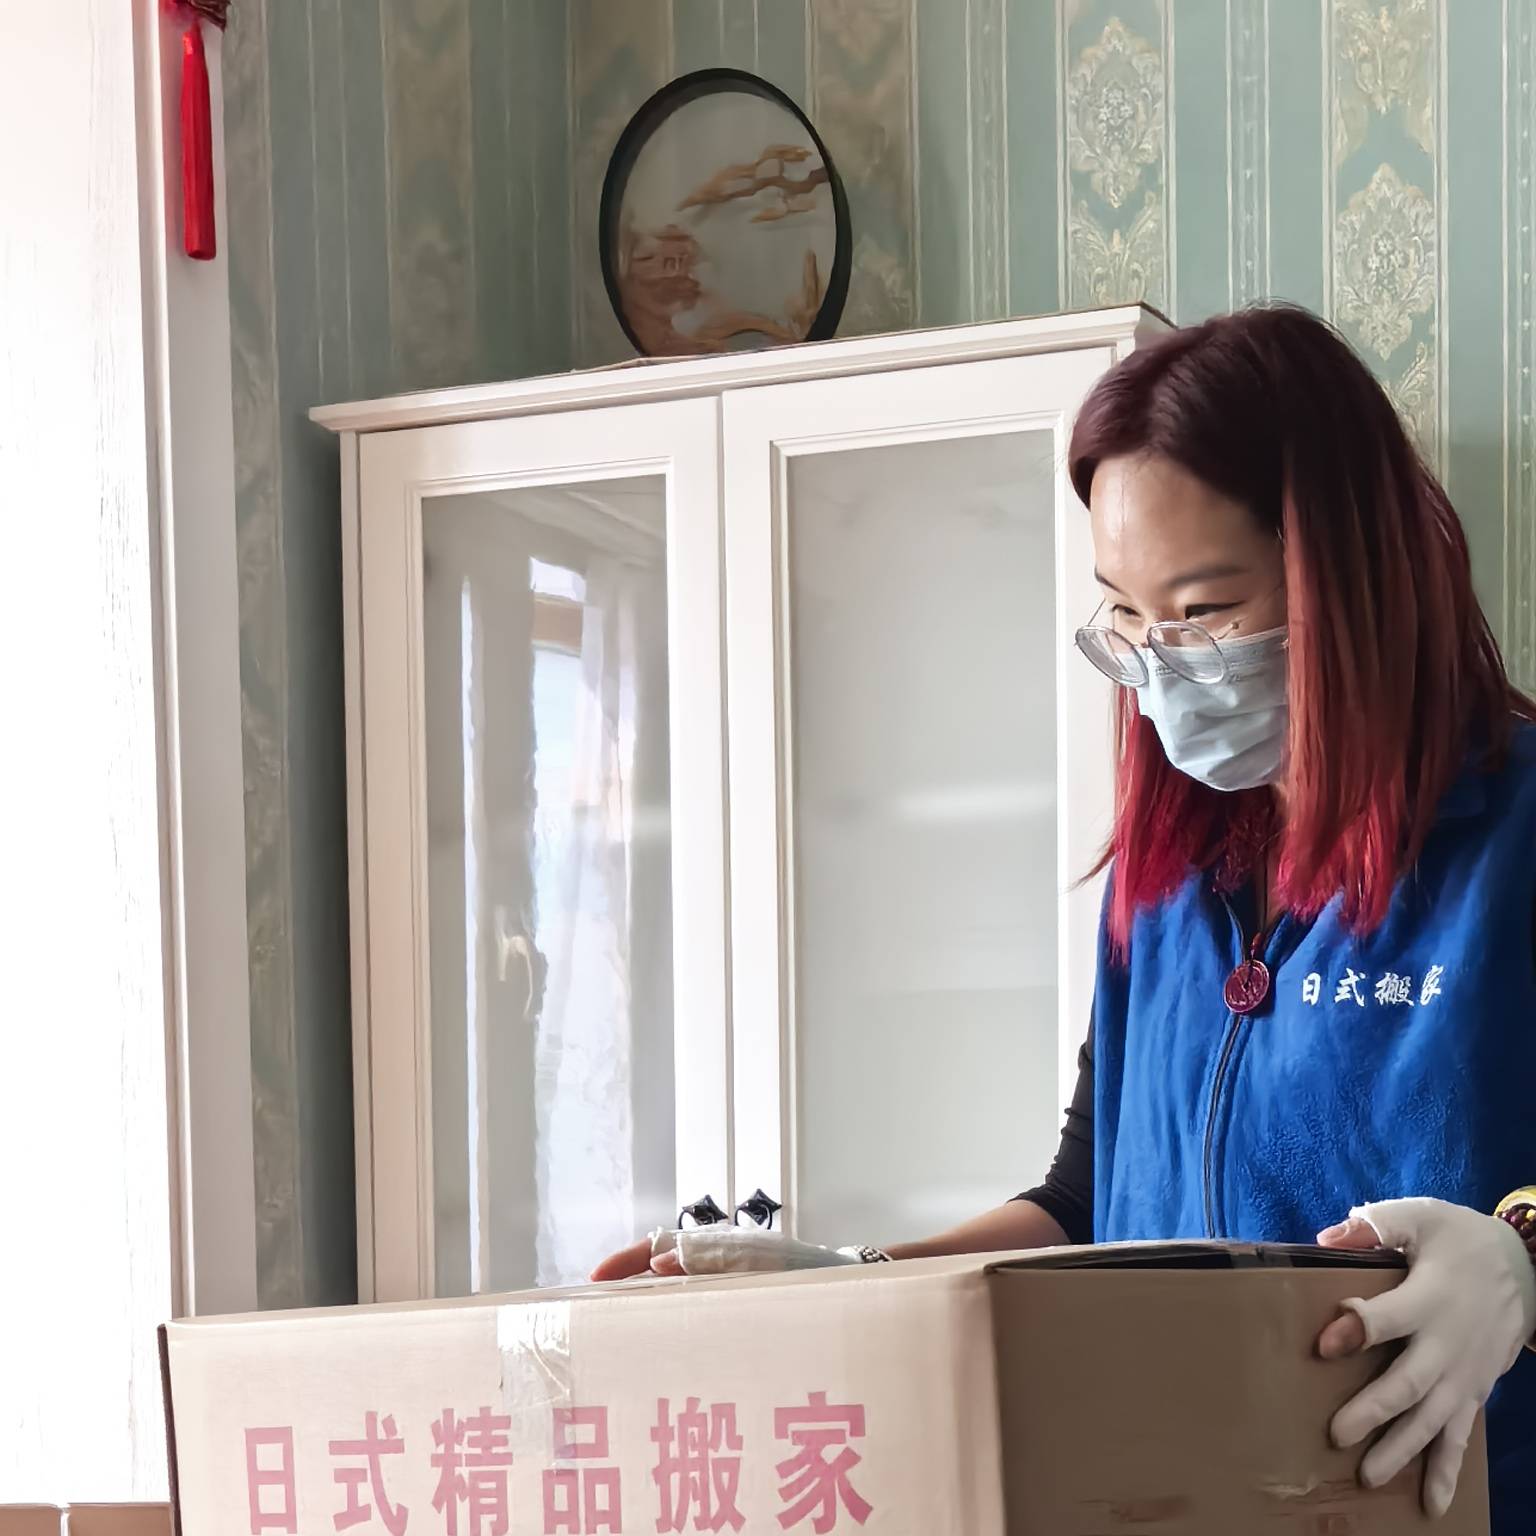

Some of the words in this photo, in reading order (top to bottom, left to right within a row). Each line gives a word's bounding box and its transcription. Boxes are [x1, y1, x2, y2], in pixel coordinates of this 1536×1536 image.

[1302, 964, 1445, 1007] 日式搬家
[245, 1391, 873, 1536] 日式精品搬家
